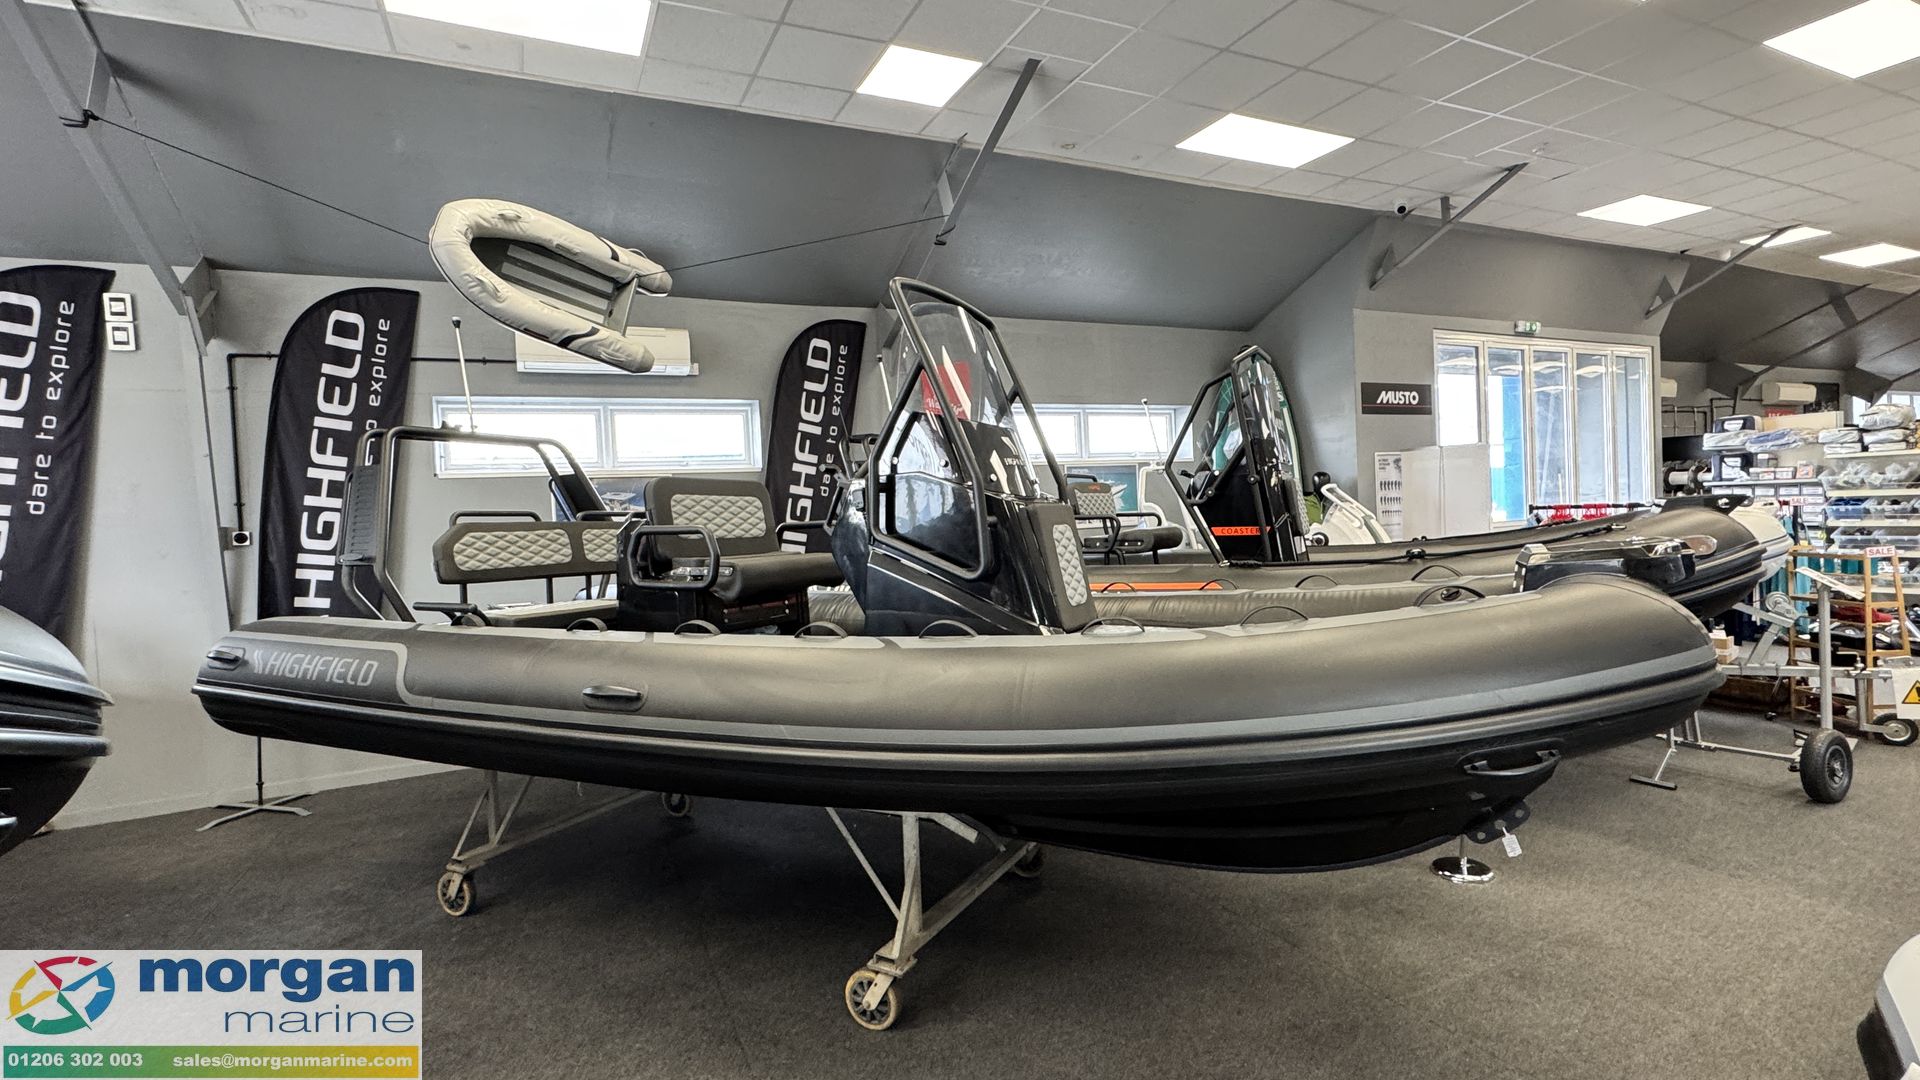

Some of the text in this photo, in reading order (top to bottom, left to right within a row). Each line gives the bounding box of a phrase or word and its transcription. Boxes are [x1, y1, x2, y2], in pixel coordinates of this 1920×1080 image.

[369, 318, 391, 407] explore
[1376, 390, 1420, 405] MUSTO
[26, 300, 75, 515] dare to explore
[820, 344, 849, 497] dae to explore
[293, 309, 366, 609] HIGHFIELD
[1868, 547, 1894, 556] SALE
[264, 651, 379, 687] HIGHFIELD
